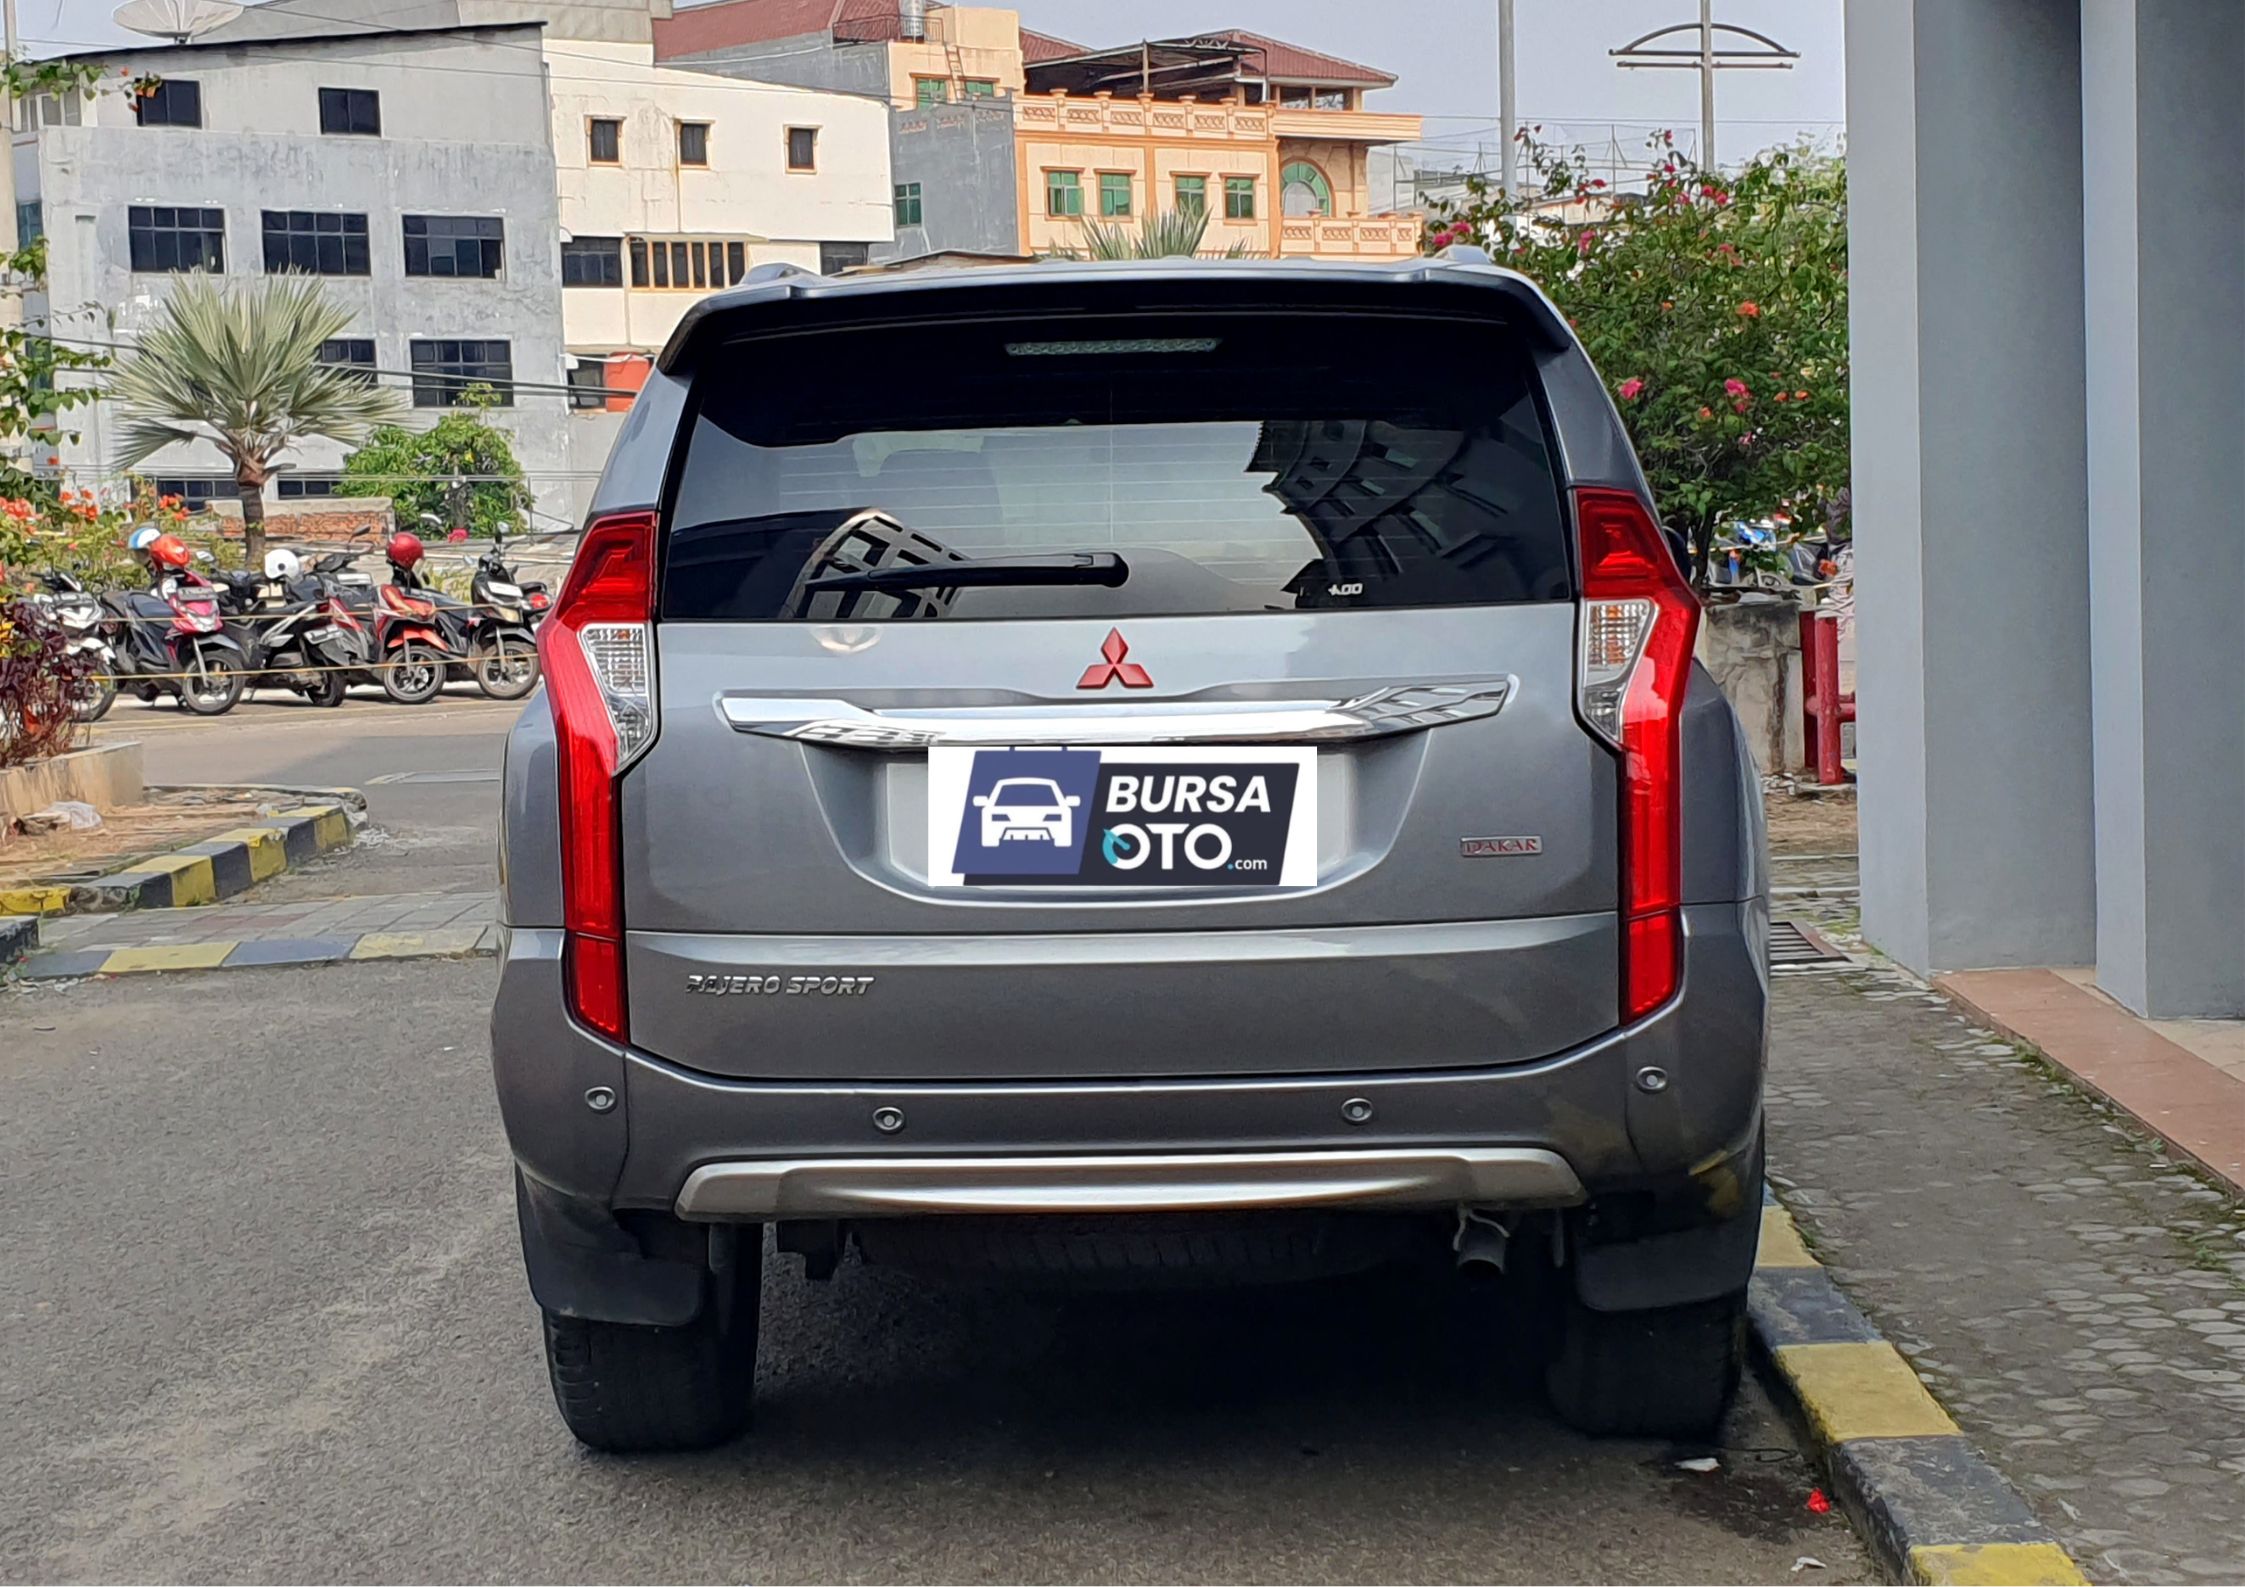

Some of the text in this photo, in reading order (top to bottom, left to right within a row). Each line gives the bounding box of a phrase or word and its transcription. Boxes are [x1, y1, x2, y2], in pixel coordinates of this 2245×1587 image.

[1462, 837, 1539, 854] DAKAR
[685, 975, 875, 996] PAJERO SPORT
